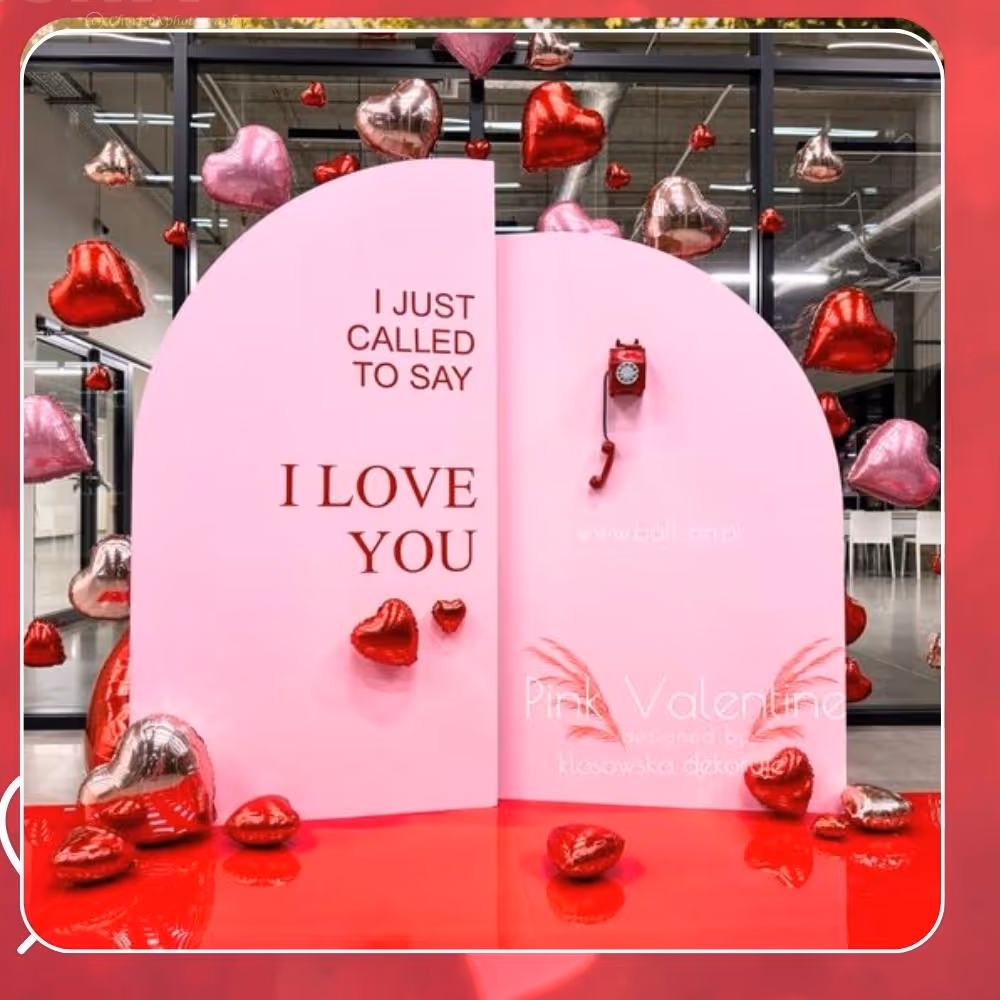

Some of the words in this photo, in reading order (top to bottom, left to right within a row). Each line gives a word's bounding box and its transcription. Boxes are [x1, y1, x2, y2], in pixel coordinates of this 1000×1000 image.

[374, 288, 382, 314] I
[392, 290, 475, 320] JUST
[346, 324, 475, 355] CALLED
[352, 360, 399, 389] TO
[409, 363, 472, 391] SAY
[280, 464, 299, 507] I
[316, 464, 477, 508] LOVE
[346, 529, 478, 574] YOU
